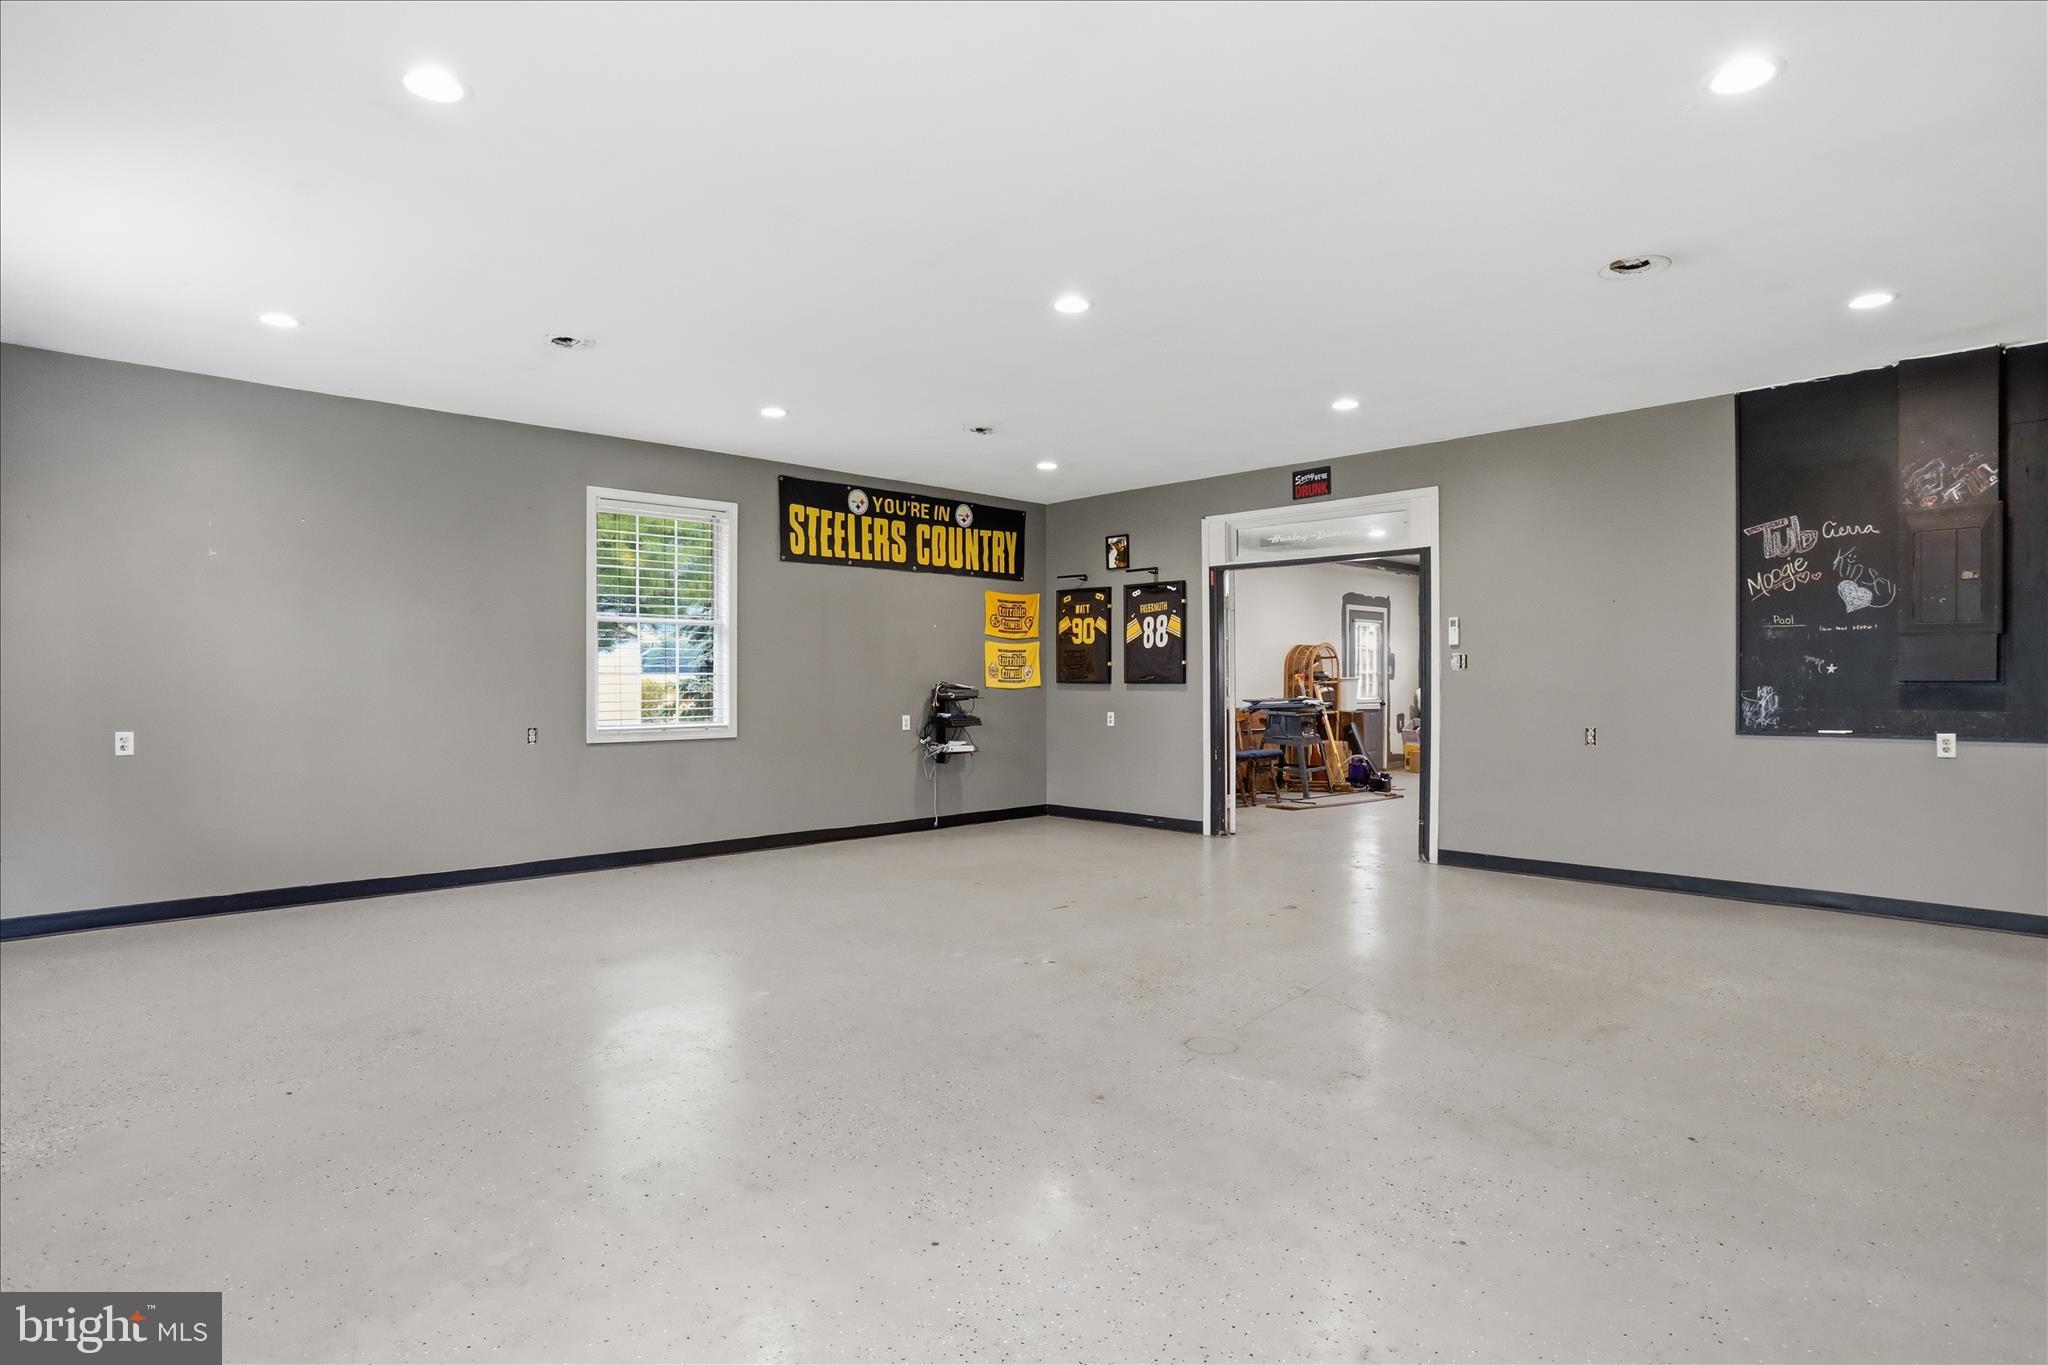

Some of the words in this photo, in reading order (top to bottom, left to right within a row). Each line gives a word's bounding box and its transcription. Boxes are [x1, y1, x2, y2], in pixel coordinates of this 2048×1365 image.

[1295, 481, 1329, 498] DRUNK
[872, 496, 930, 519] YOU'RE
[934, 505, 951, 522] IN
[789, 503, 907, 563] STEELERS
[916, 523, 1018, 575] COUNTRY
[1267, 528, 1356, 543] Harley-Davi
[1747, 556, 1808, 596] Moogie
[1072, 617, 1096, 645] 90
[1143, 614, 1169, 649] 88
